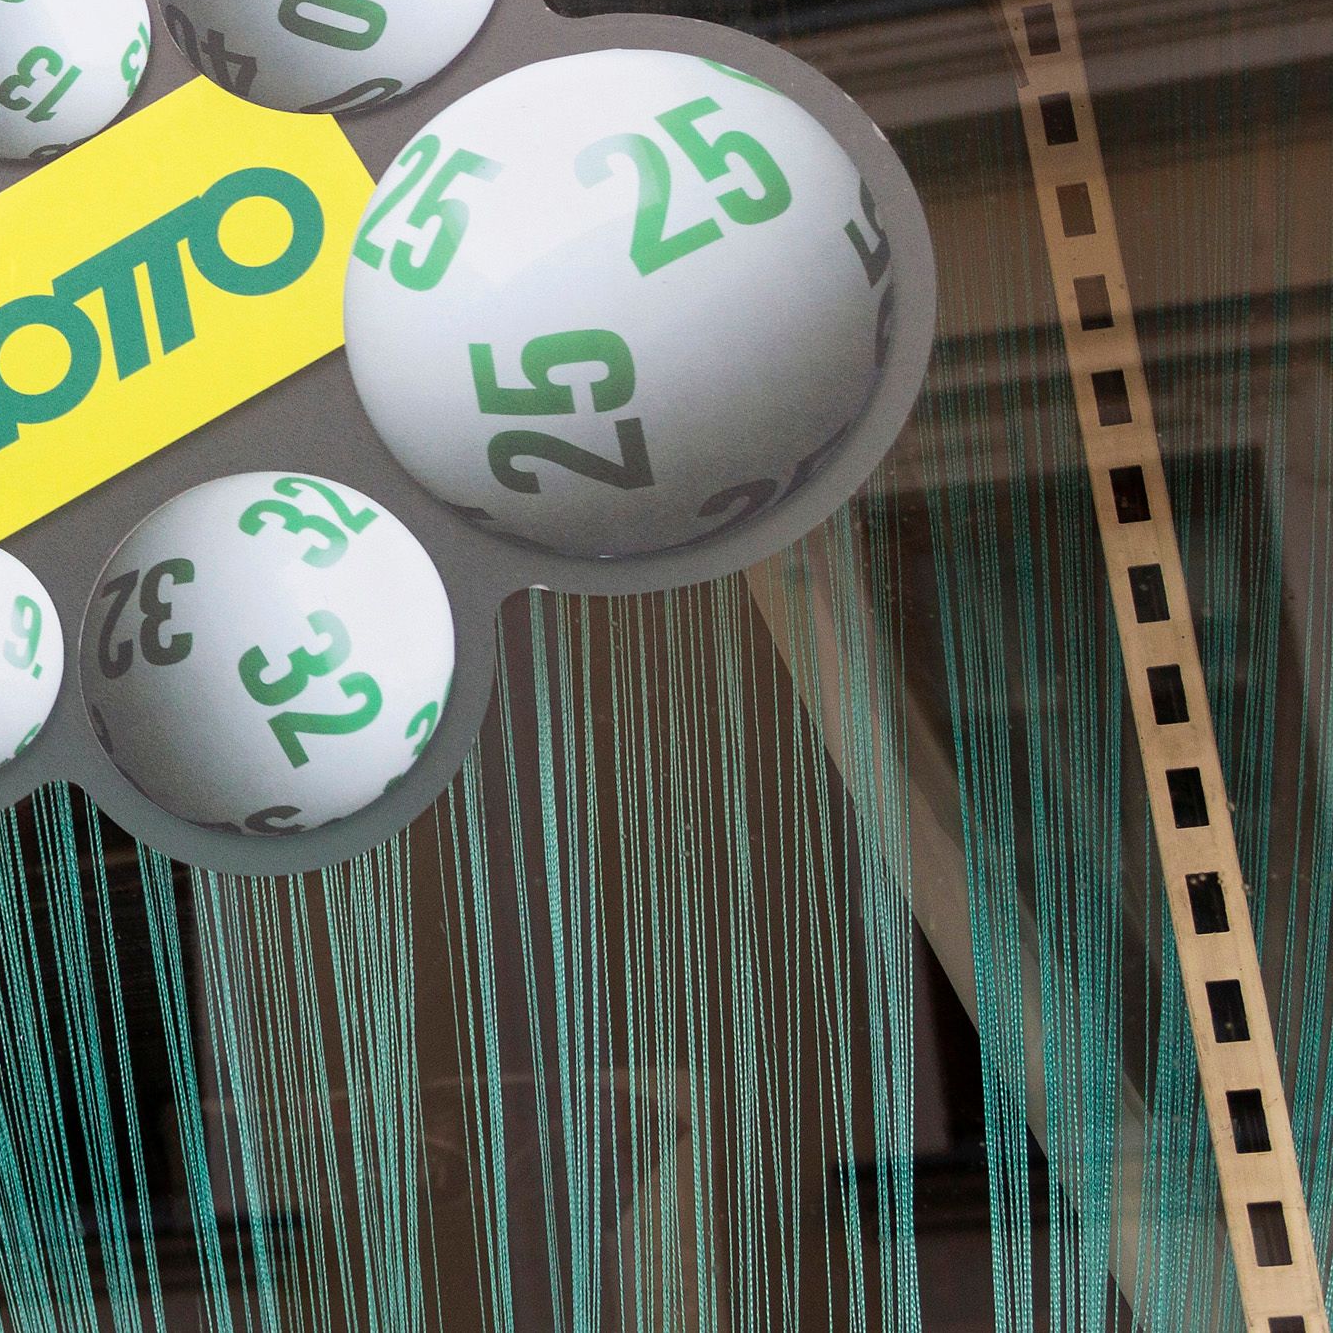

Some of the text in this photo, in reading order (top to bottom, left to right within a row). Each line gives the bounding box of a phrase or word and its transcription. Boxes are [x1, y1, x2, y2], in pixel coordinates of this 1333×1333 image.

[352, 133, 503, 292] 25
[574, 97, 791, 277] 25
[468, 327, 654, 494] 25
[239, 477, 379, 569] 32
[98, 558, 195, 680] 32
[238, 609, 383, 769] 32
